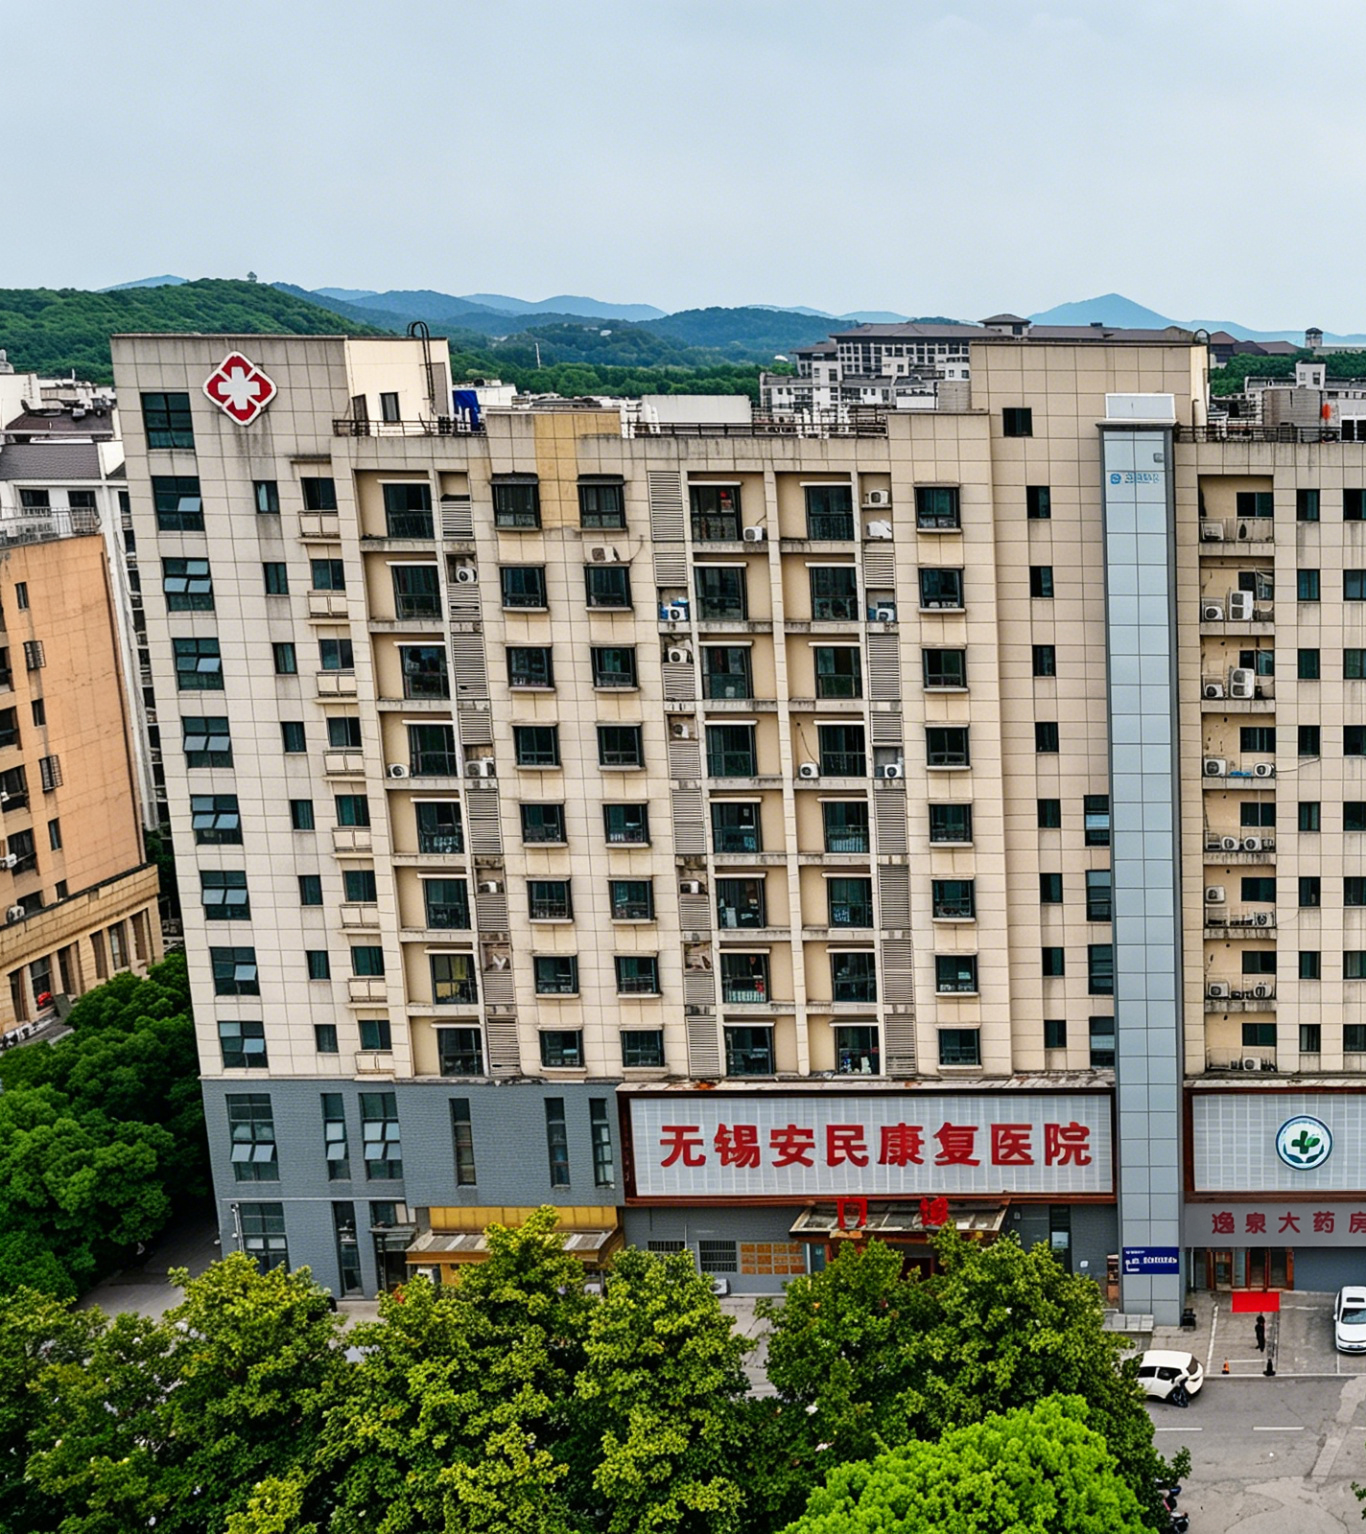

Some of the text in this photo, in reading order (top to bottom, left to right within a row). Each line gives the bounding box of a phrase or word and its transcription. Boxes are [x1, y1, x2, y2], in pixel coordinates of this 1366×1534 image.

[659, 1121, 1092, 1169] 无锡安民康复医院
